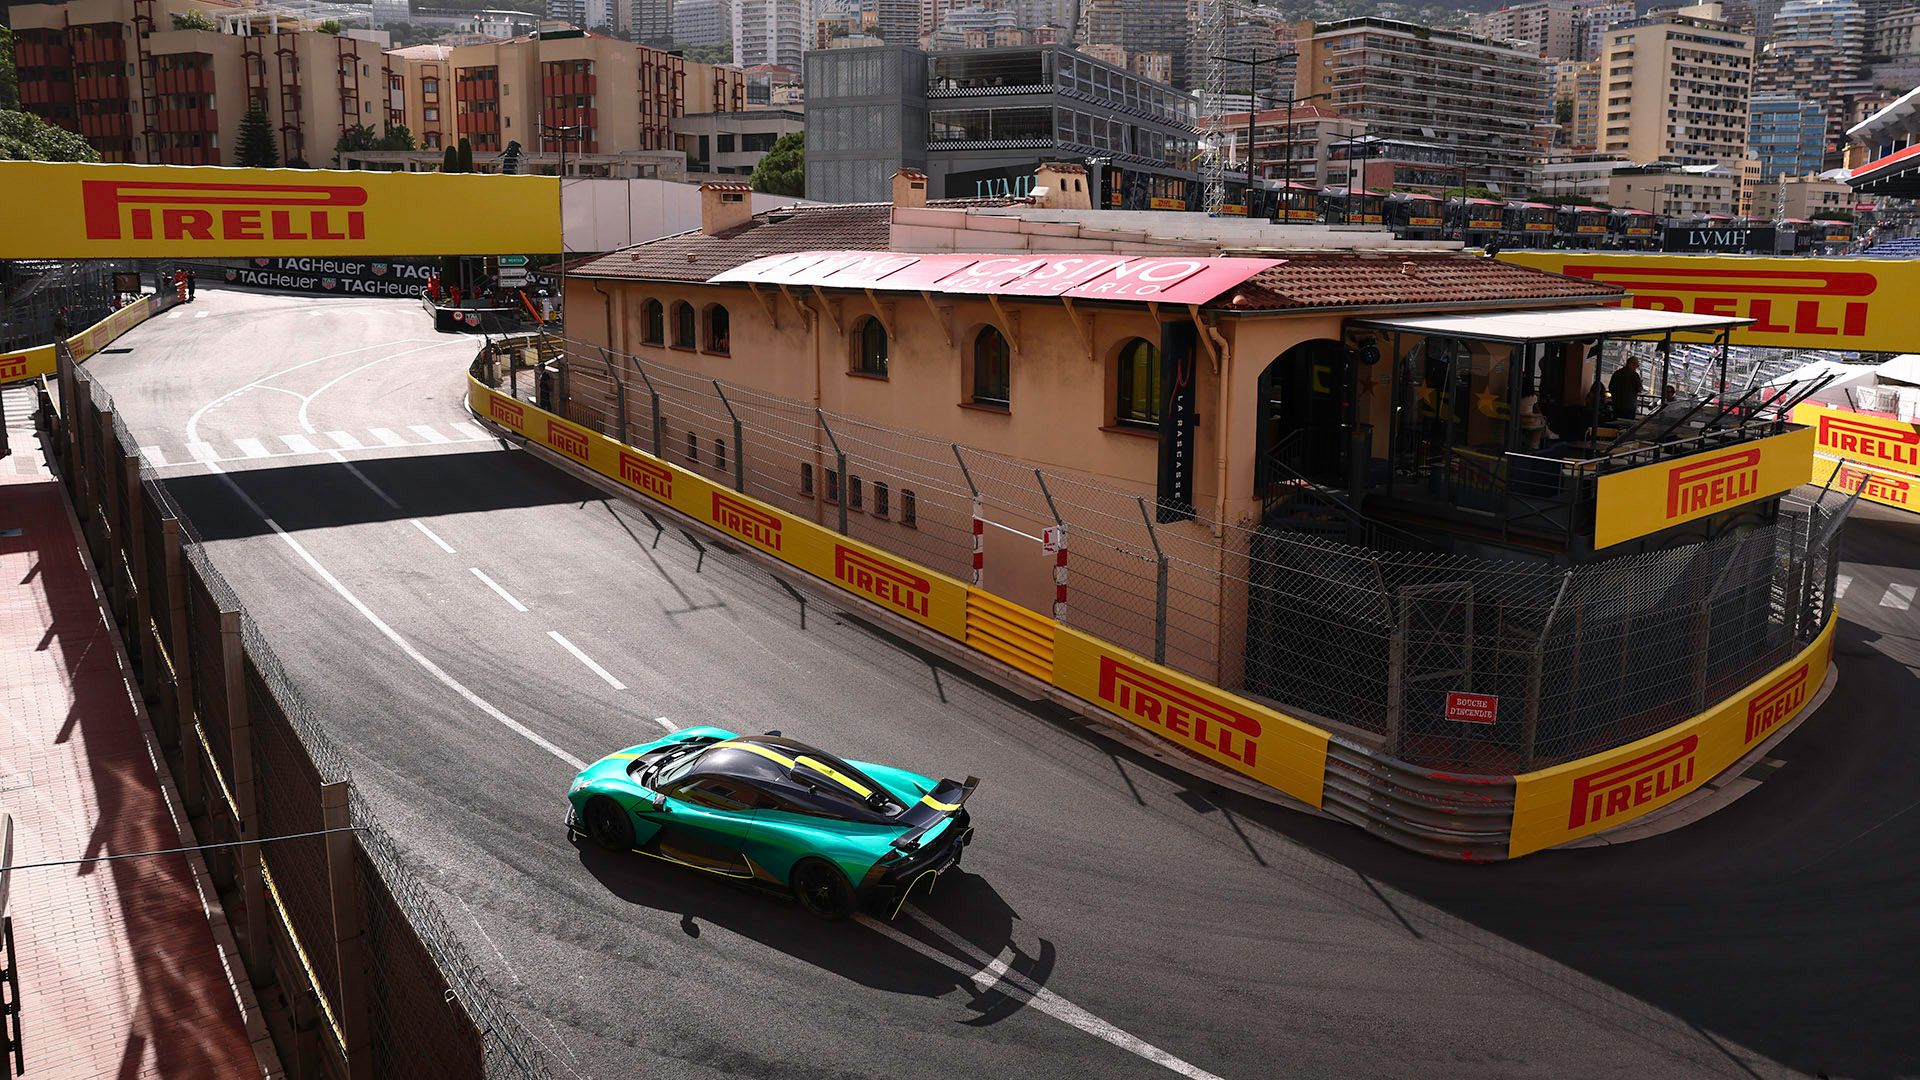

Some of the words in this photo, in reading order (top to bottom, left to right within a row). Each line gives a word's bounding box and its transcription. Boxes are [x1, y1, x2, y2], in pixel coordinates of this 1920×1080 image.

[82, 180, 368, 240] PIRELLI
[1689, 230, 1746, 246] LVMH
[966, 257, 1201, 282] CASINO
[1563, 265, 1877, 336] PELLI
[489, 394, 524, 430] PIRELLI
[1176, 395, 1184, 412] LA
[547, 420, 589, 461] PIRELLI
[1174, 420, 1184, 498] RASCASSE
[1819, 415, 1920, 466] PIRELLI
[619, 451, 673, 500] PIRELLI
[1666, 448, 1761, 519] PIRELLI
[711, 491, 782, 551] PIRELLI
[835, 543, 931, 617] PIRELLI
[1100, 655, 1262, 768] PIRELLI
[1456, 698, 1488, 708] BOUCHE
[1744, 662, 1809, 745] PIRELLI
[1568, 734, 1698, 830] PIRELLI
